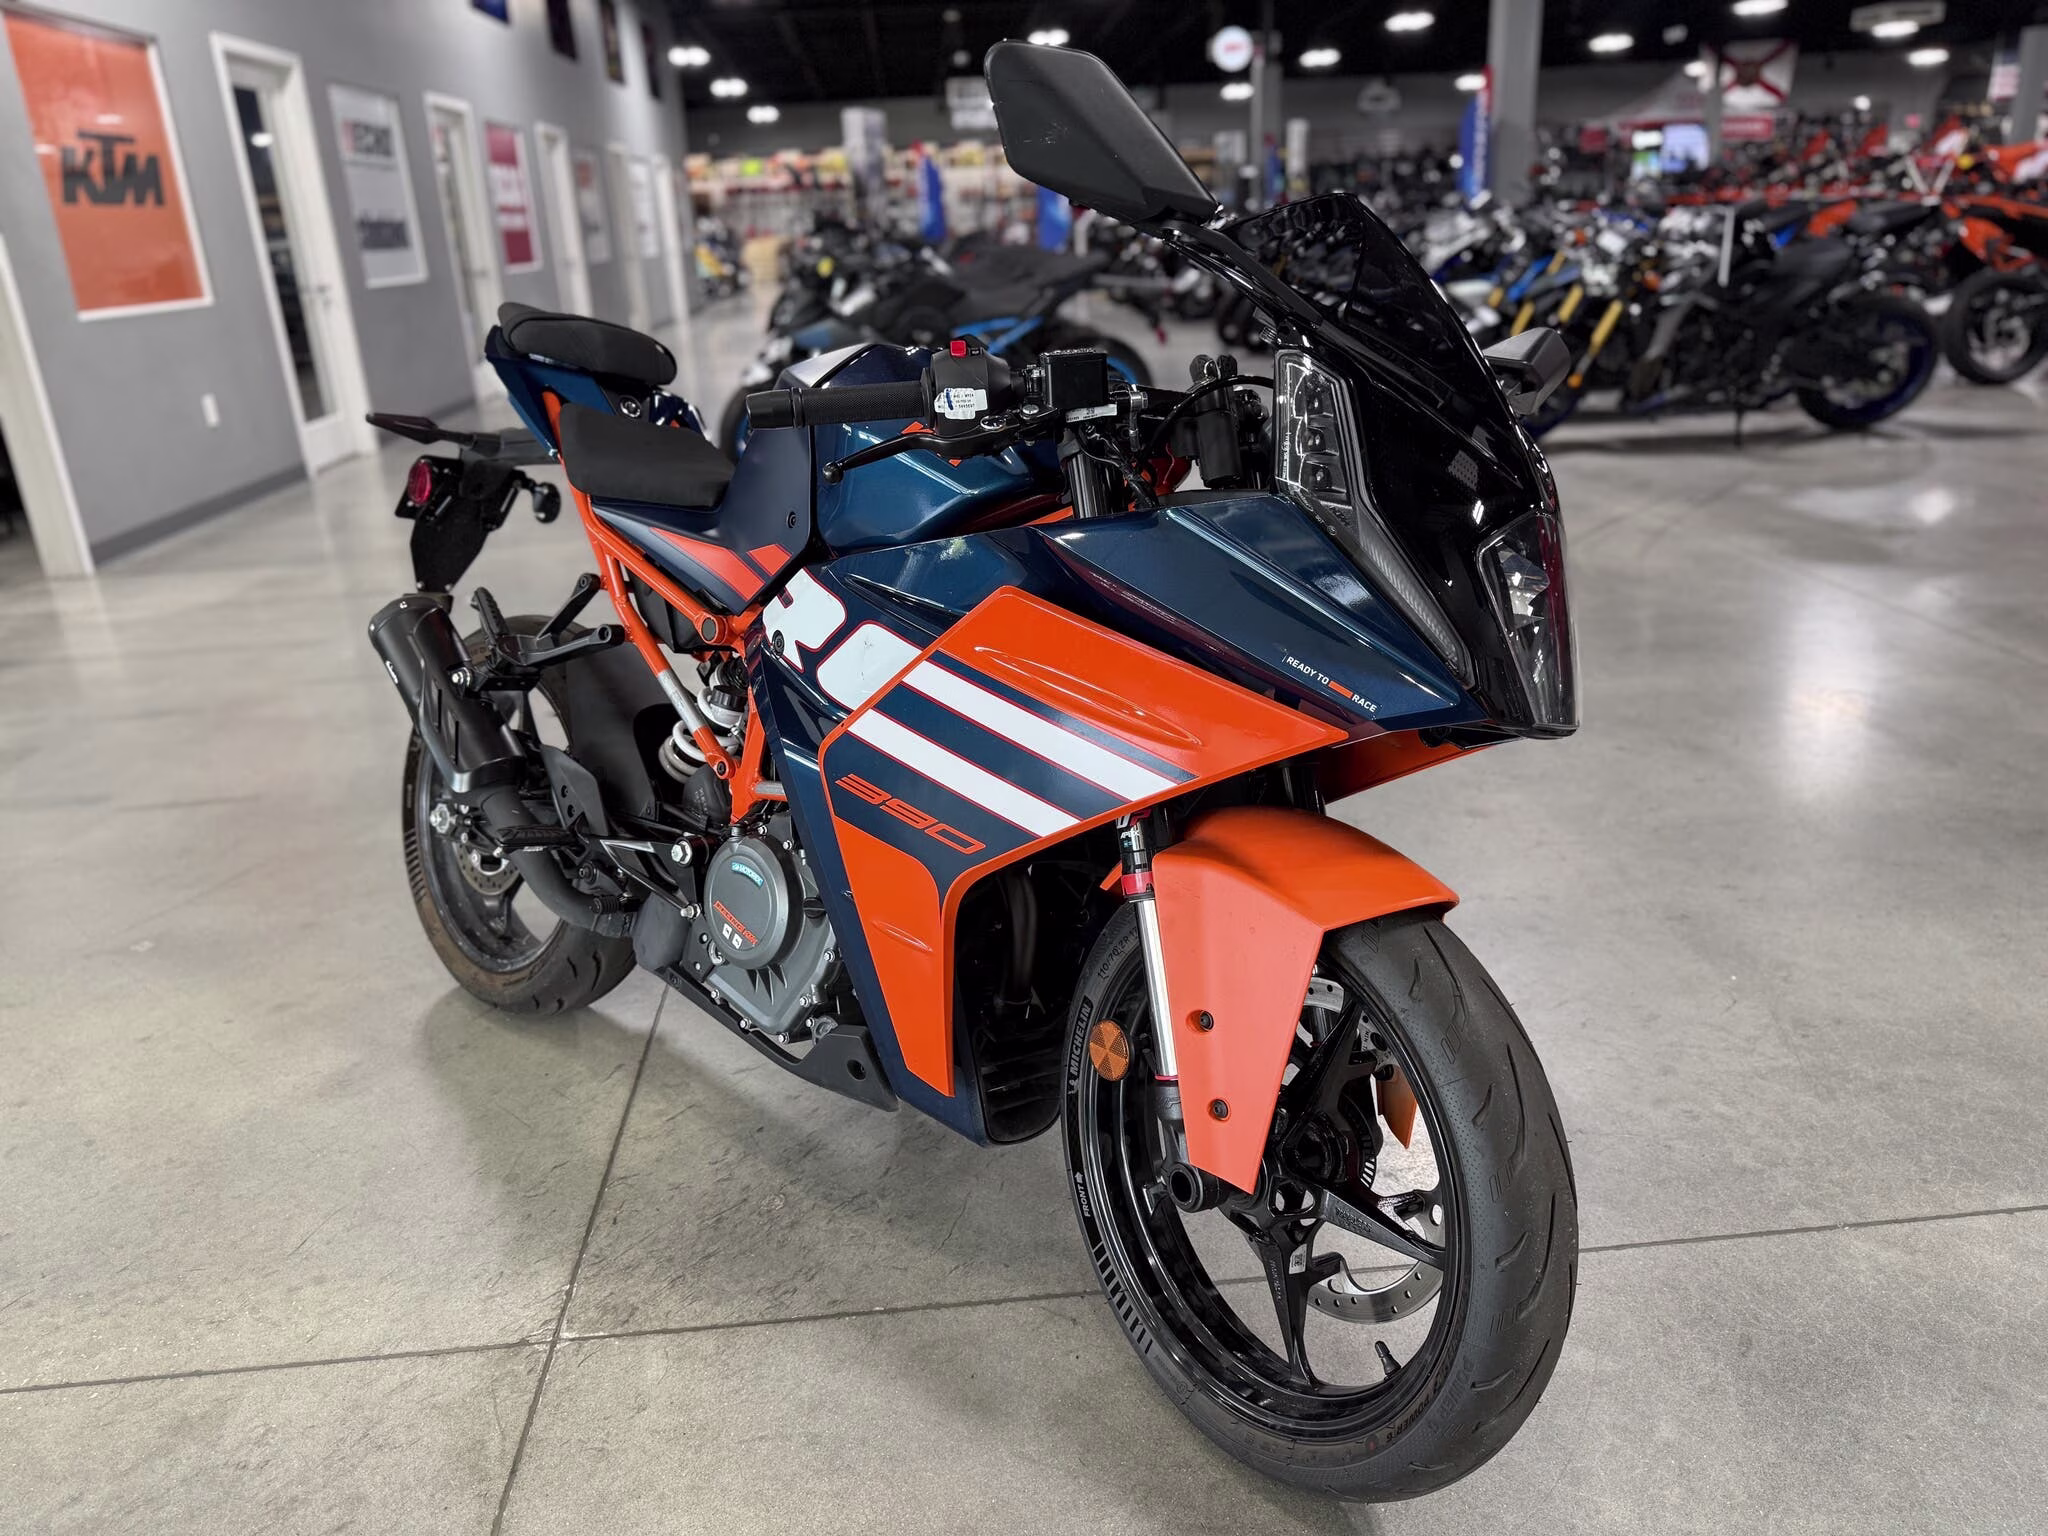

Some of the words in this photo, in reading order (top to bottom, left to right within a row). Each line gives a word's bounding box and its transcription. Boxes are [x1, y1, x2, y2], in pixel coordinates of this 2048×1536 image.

[62, 129, 164, 206] KTM
[1286, 656, 1317, 677] READY
[1315, 672, 1330, 685] TO
[1351, 694, 1378, 713] RACE
[835, 773, 986, 855] 390
[1069, 1002, 1092, 1079] MICHELIN
[1077, 1183, 1091, 1217] FRONT
[1396, 1392, 1431, 1435] POWER
